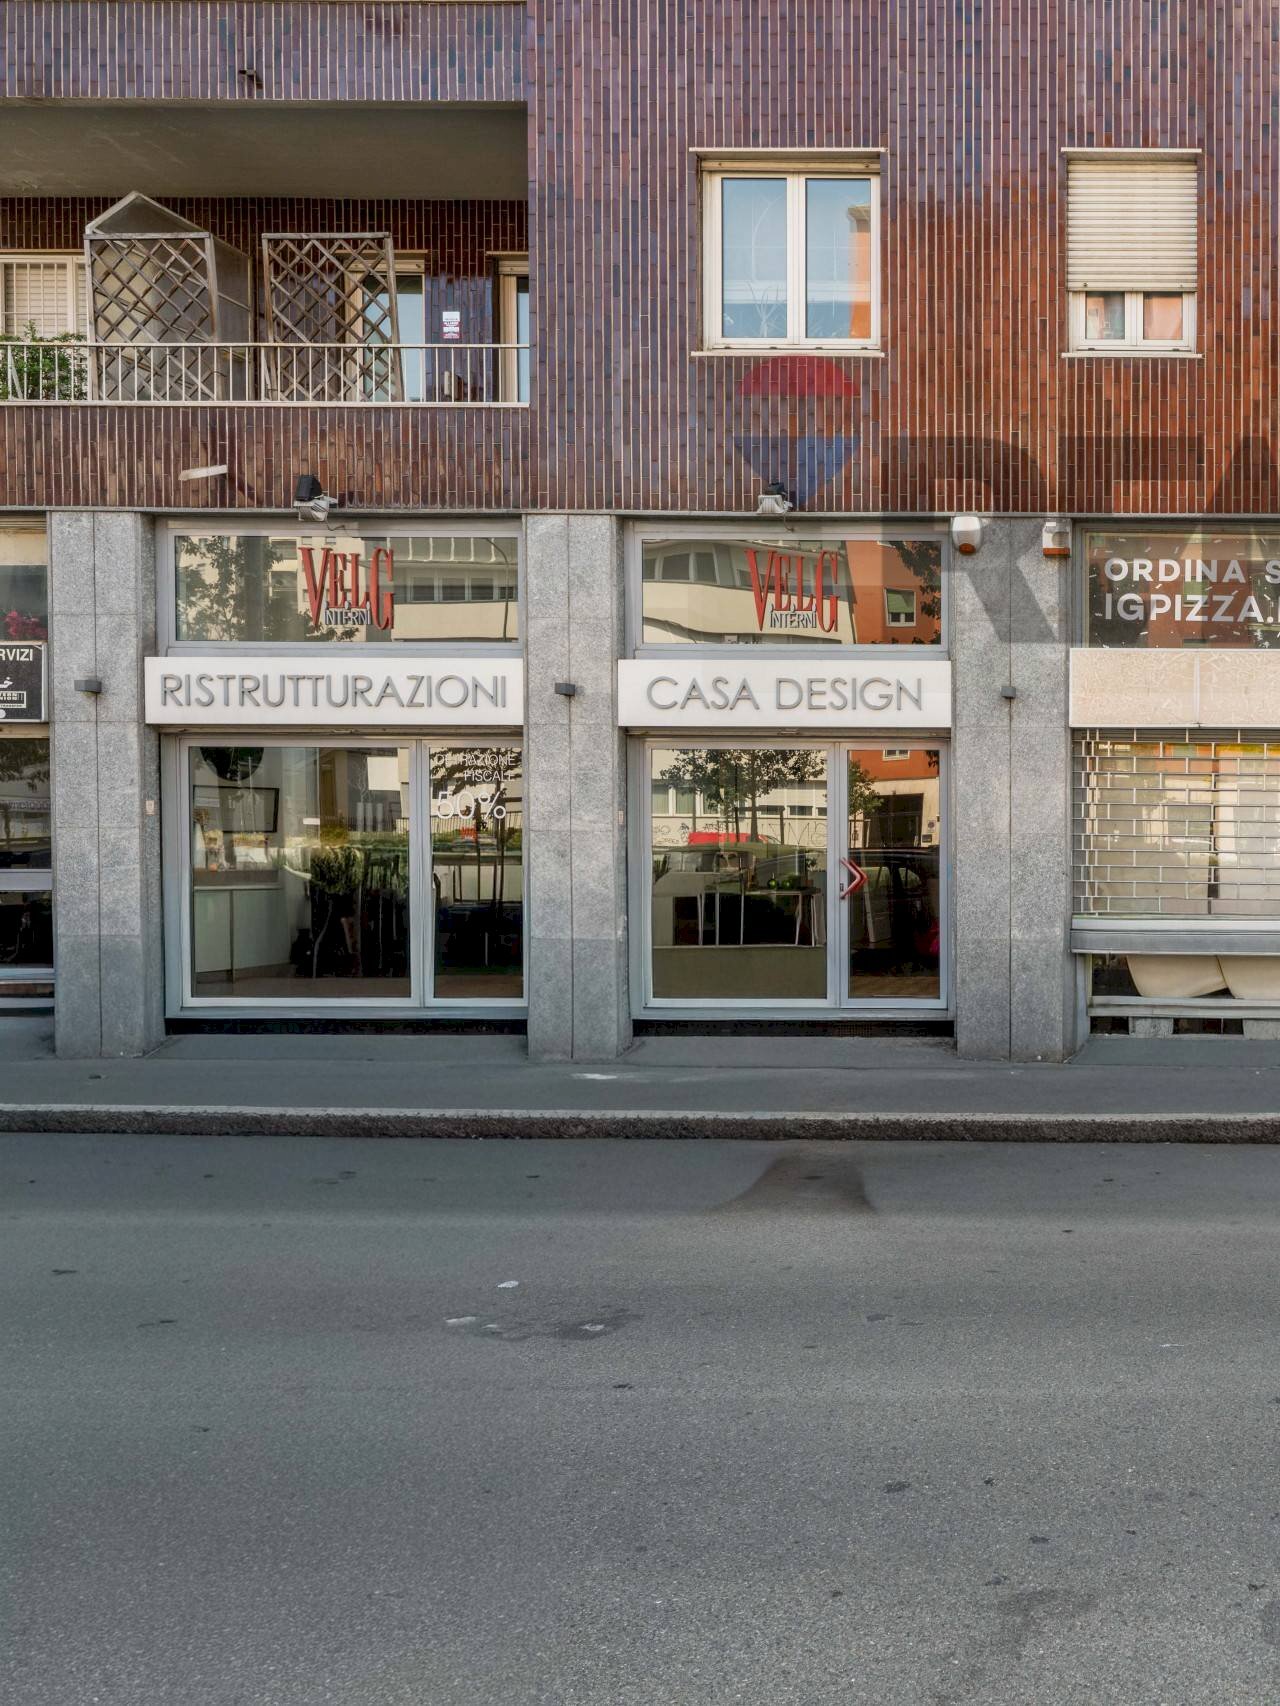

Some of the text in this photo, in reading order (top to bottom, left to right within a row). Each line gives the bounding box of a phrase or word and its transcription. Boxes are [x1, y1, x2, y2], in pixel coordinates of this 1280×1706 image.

[1104, 557, 1246, 583] ORDINA
[323, 601, 373, 626] INTERNI
[769, 603, 817, 629] INTERNI
[160, 673, 508, 708] RISTRUTTURAZIONI
[647, 675, 922, 711] CASA DESIGN
[435, 754, 516, 766] DERAZIONE
[437, 791, 507, 820] 50%
